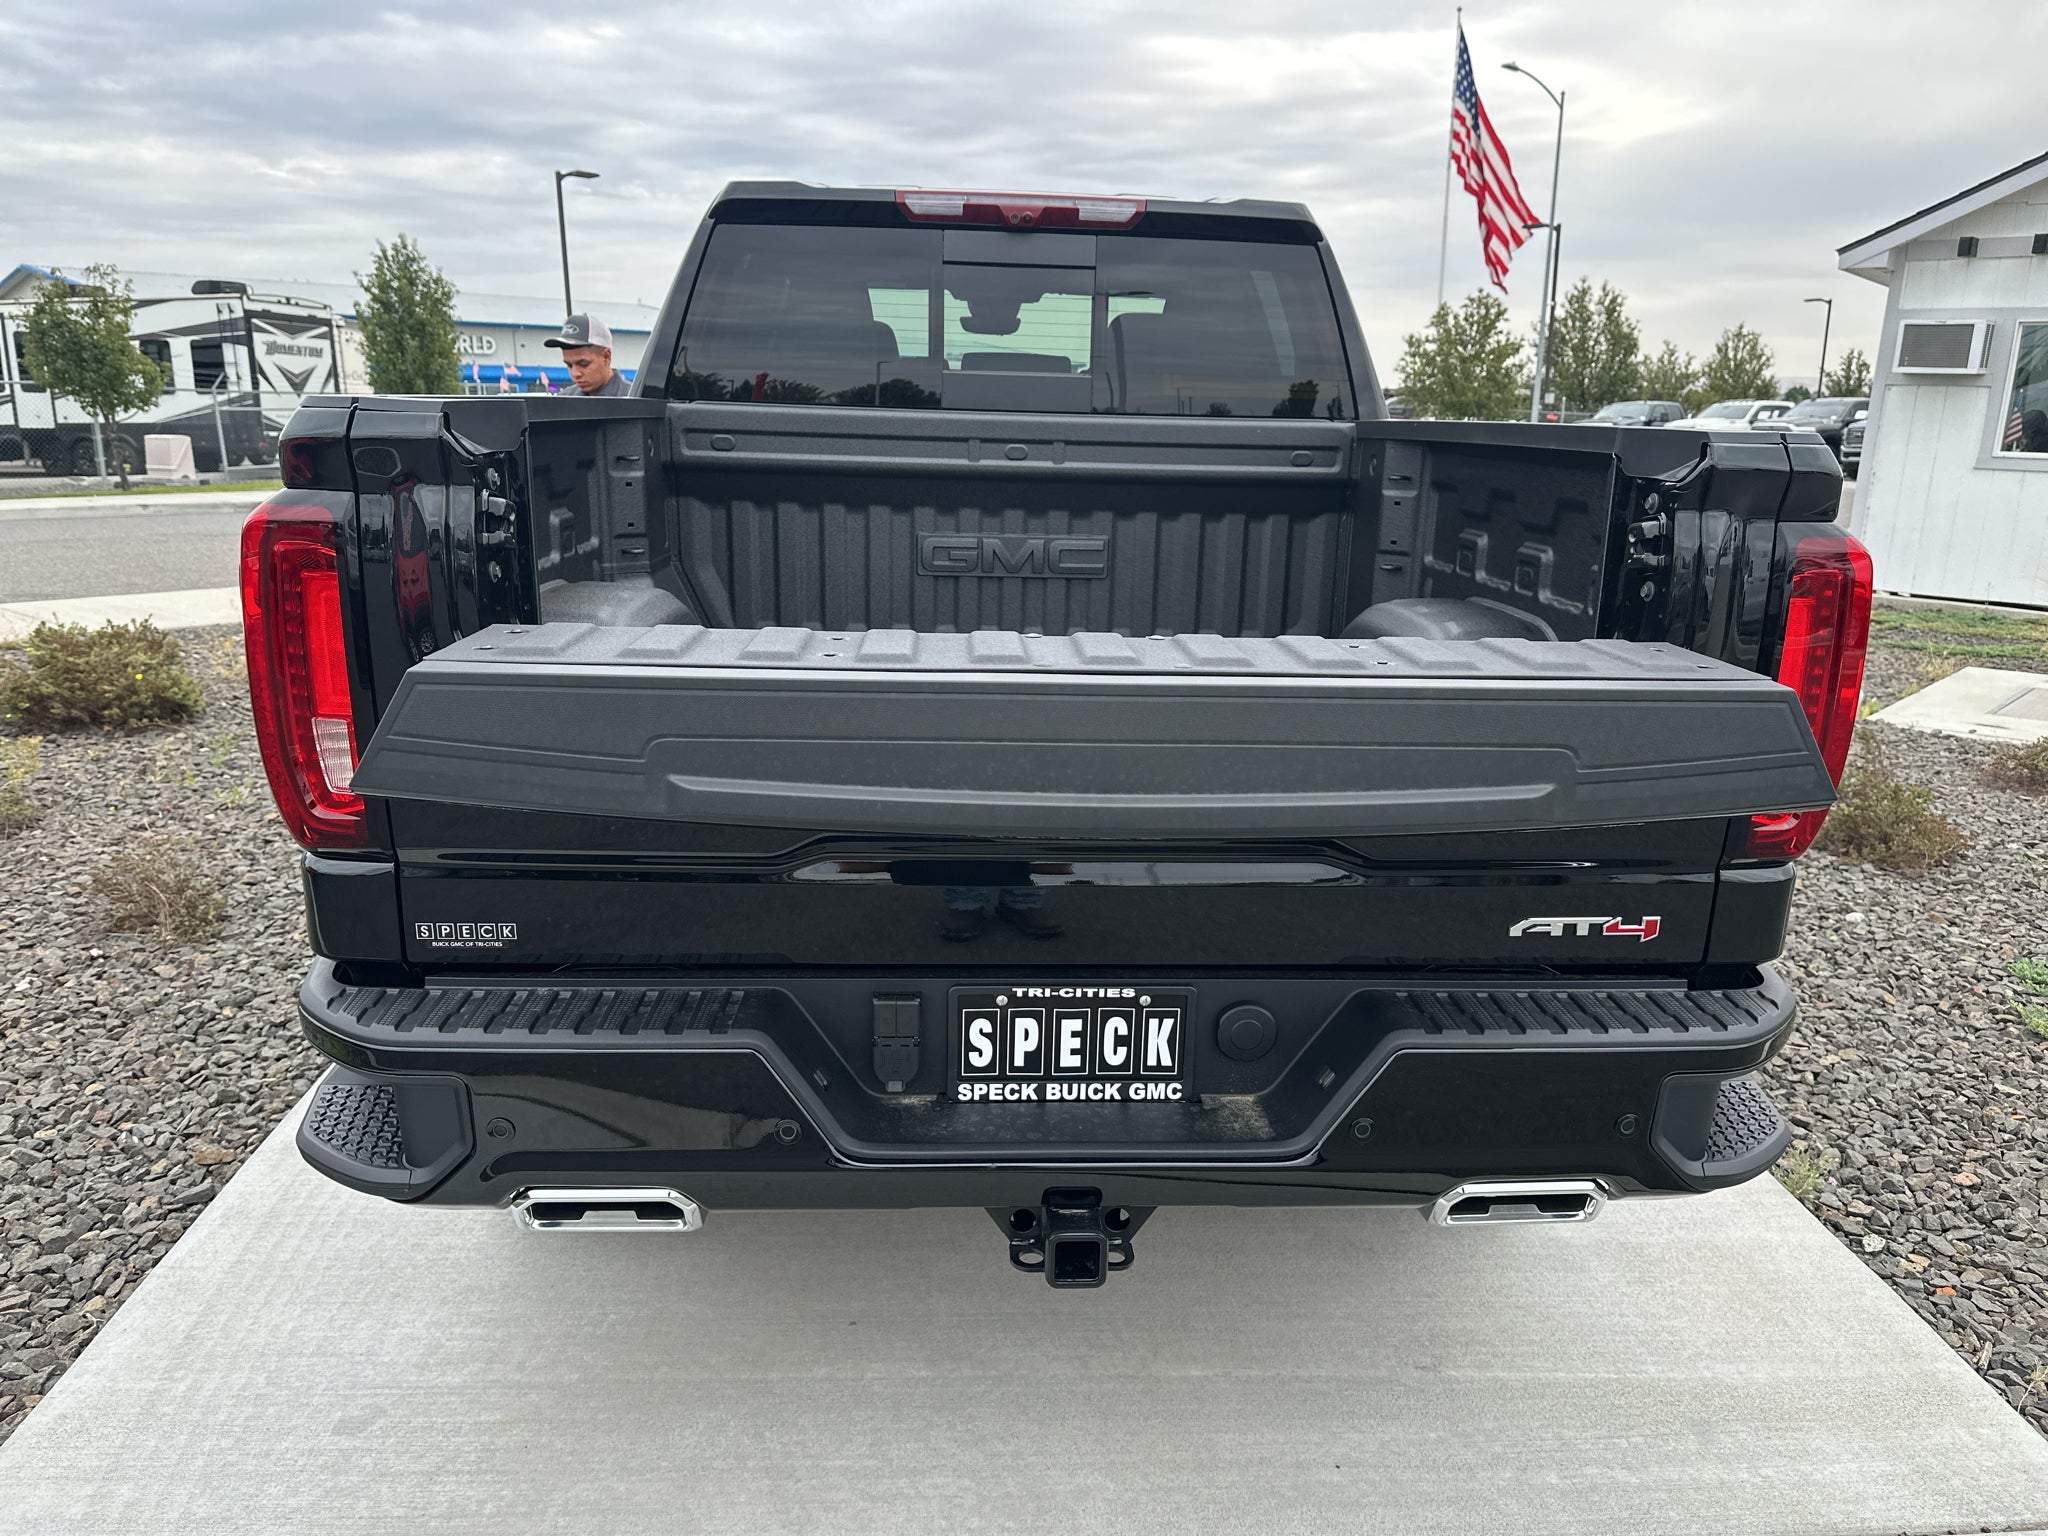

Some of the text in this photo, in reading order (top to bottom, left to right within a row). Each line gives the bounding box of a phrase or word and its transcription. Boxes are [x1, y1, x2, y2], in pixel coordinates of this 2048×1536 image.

[262, 340, 323, 358] MOMENTUM
[453, 334, 496, 354] RLD
[920, 537, 1105, 575] GMC
[419, 925, 513, 938] SPECK
[1509, 916, 1661, 942] AT4
[1012, 987, 1136, 998] TRI-CITIES
[968, 1016, 1175, 1068] SPECK
[957, 1082, 1183, 1101] SPECK BUICK GMC
